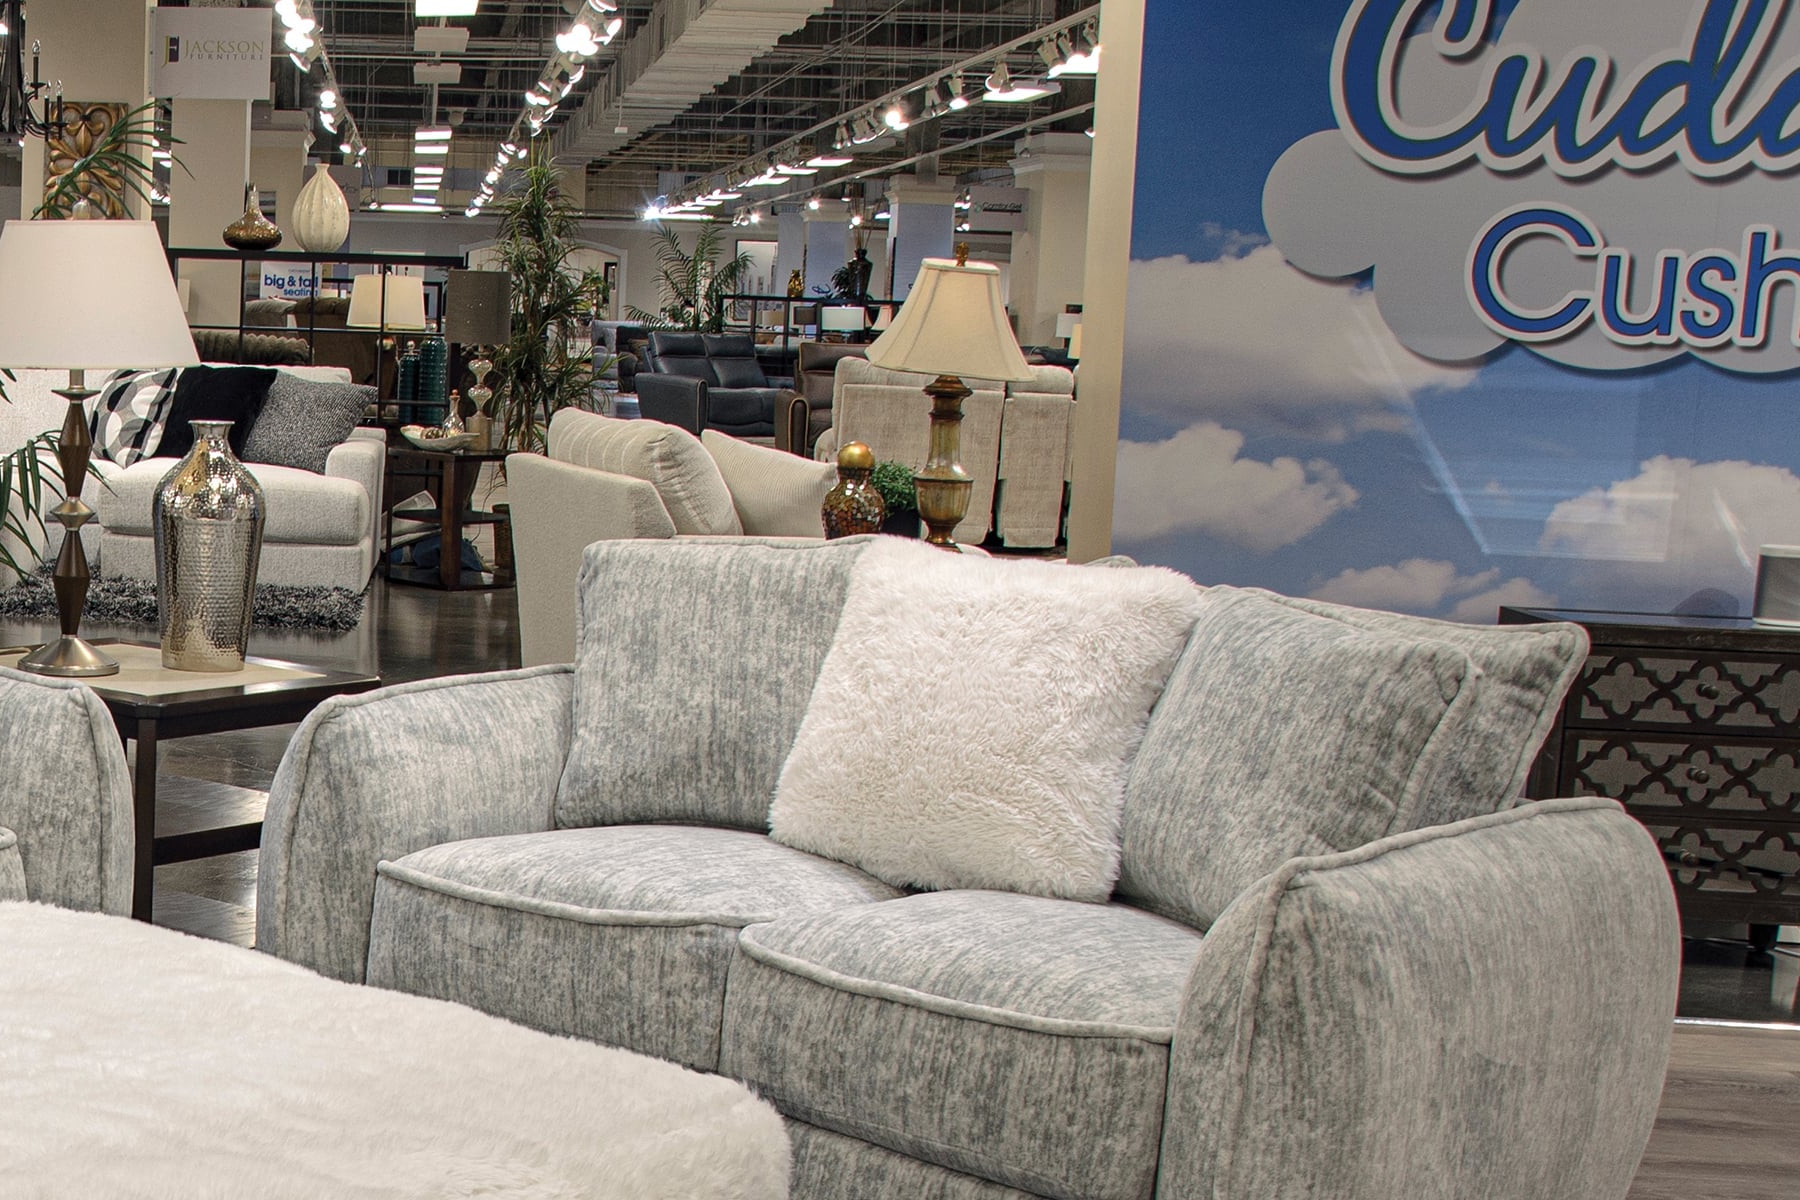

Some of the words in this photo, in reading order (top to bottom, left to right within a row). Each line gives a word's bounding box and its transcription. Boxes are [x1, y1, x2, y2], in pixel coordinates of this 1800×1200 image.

[184, 40, 264, 58] JACKSON
[1338, 0, 1800, 168] Cud
[264, 274, 286, 289] big
[287, 275, 296, 287] &
[298, 275, 318, 287] tal
